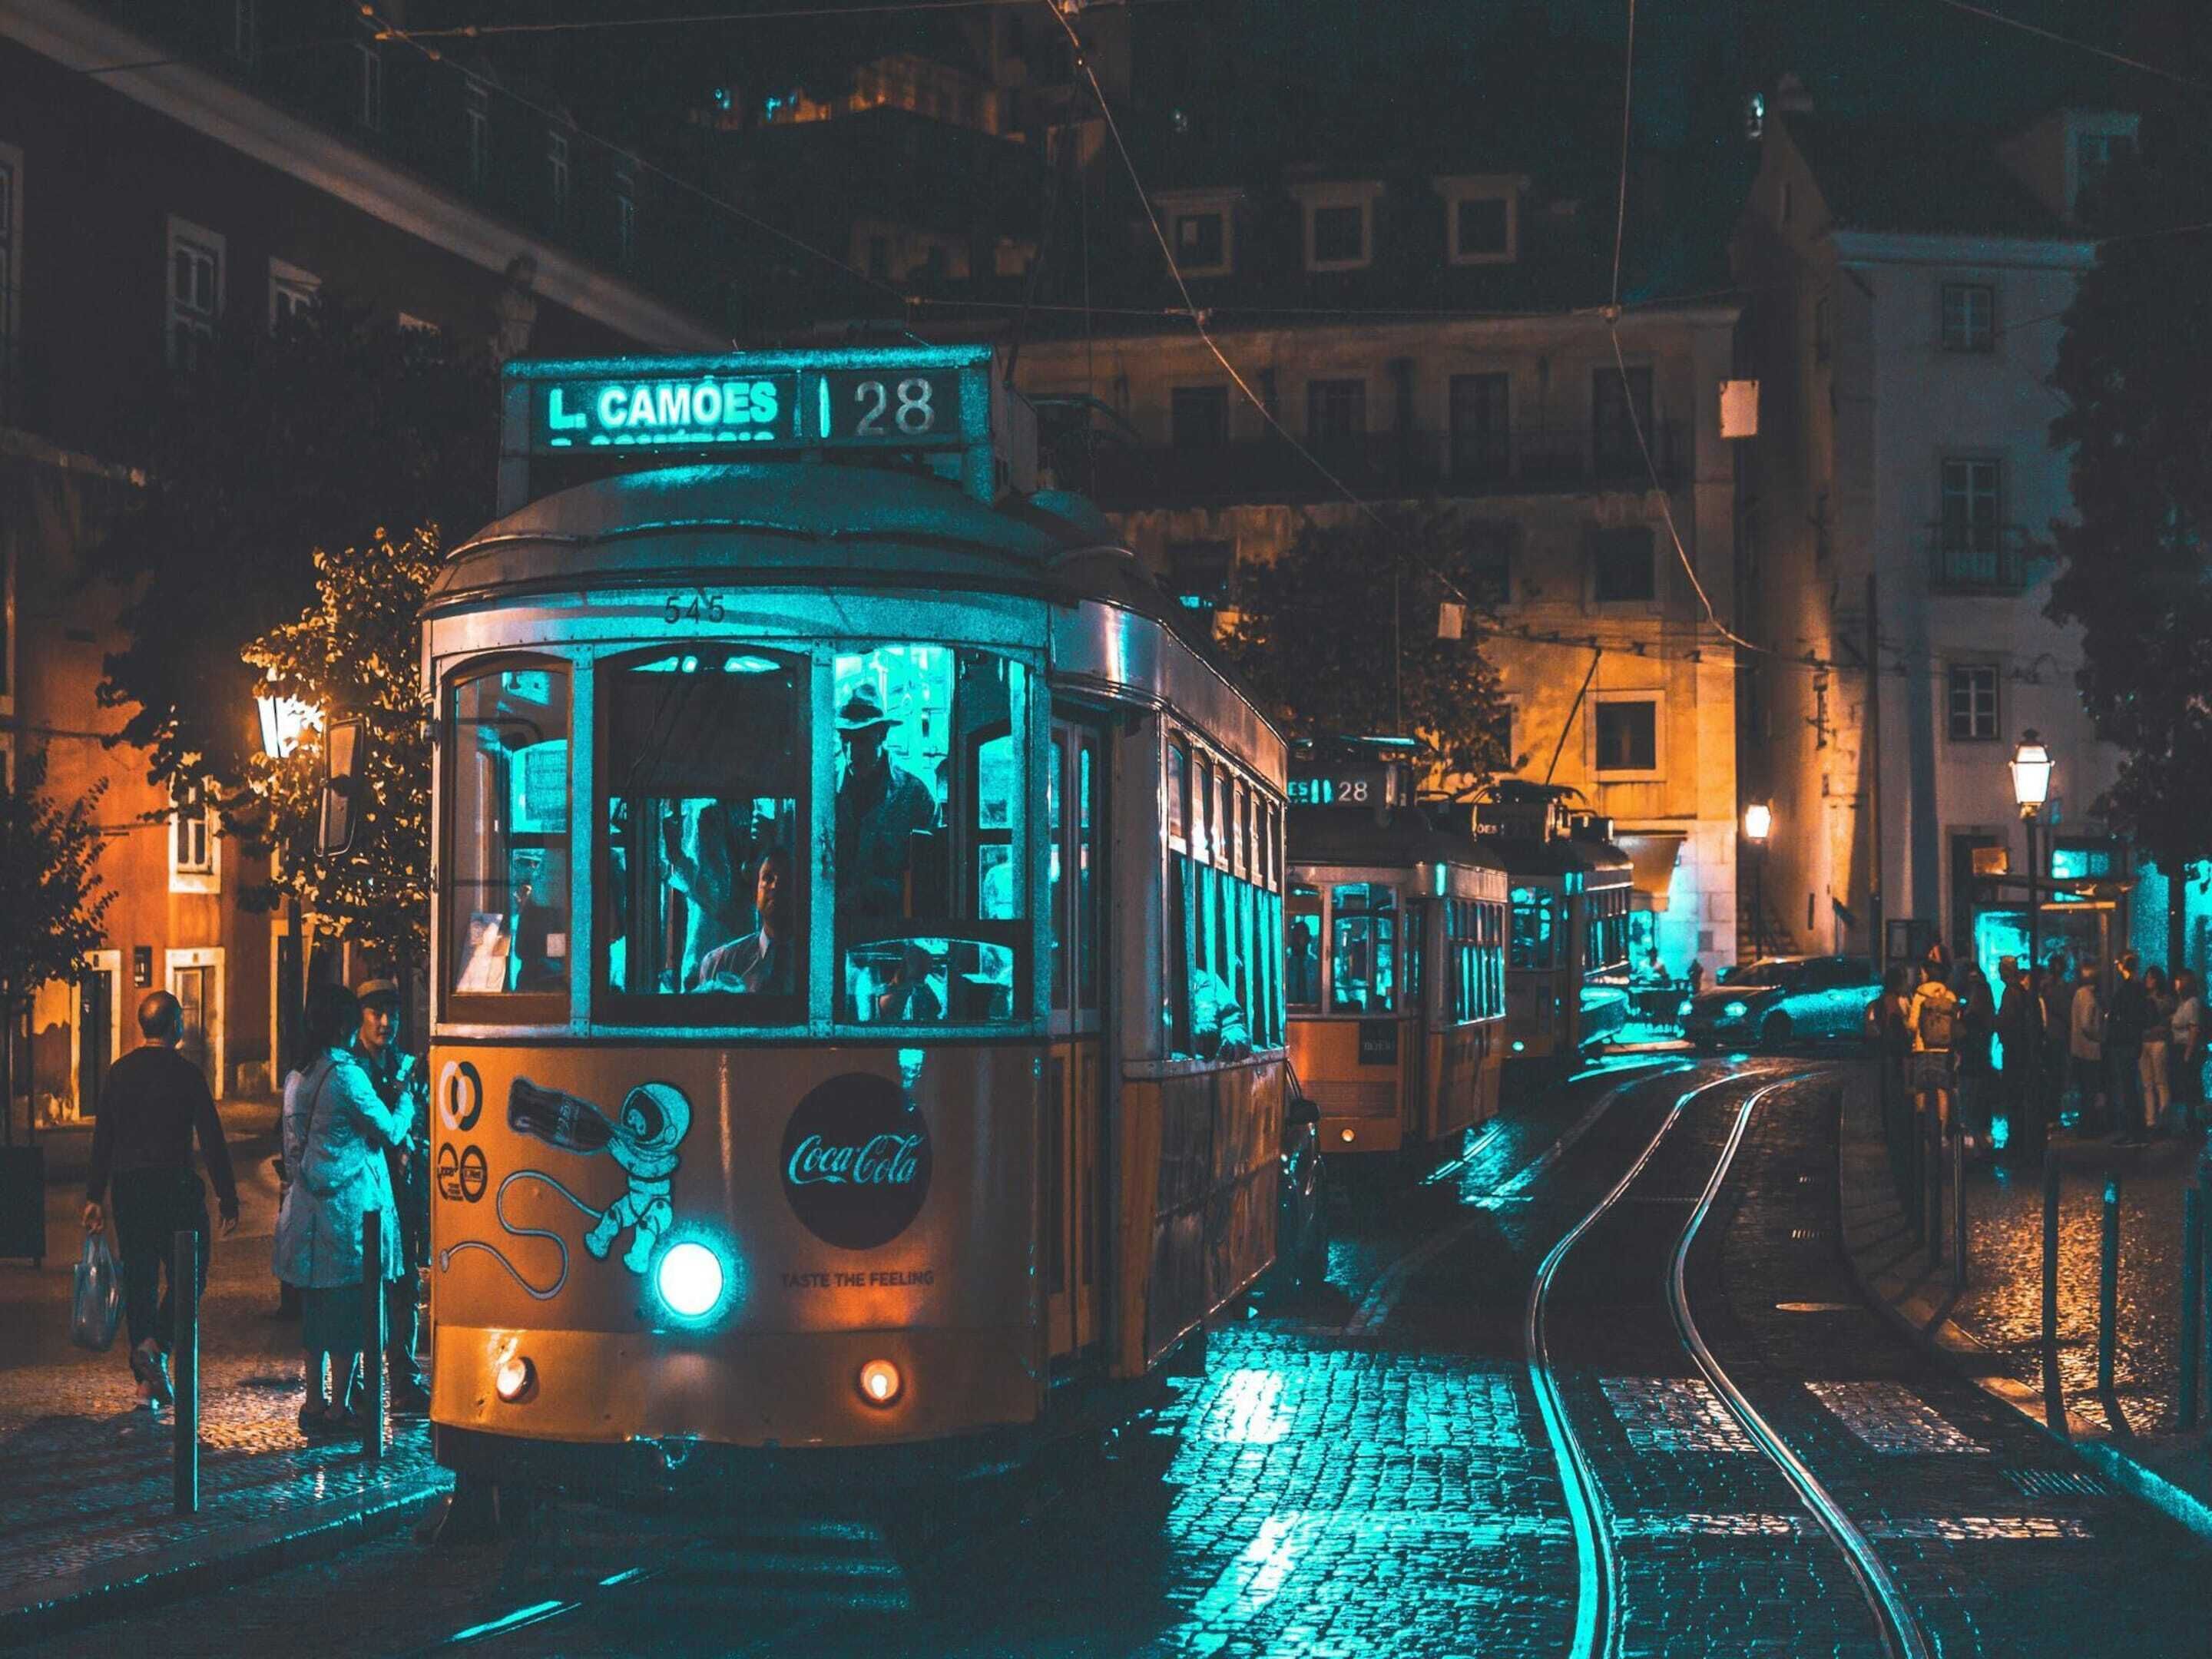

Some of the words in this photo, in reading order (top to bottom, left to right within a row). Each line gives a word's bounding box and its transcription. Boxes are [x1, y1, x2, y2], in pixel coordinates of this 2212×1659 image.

[855, 378, 935, 435] 28
[664, 595, 725, 624] 545
[1338, 781, 1368, 801] 28
[781, 1272, 830, 1288] TASTE
[834, 1271, 865, 1287] THE
[869, 1270, 934, 1286] FEELING
